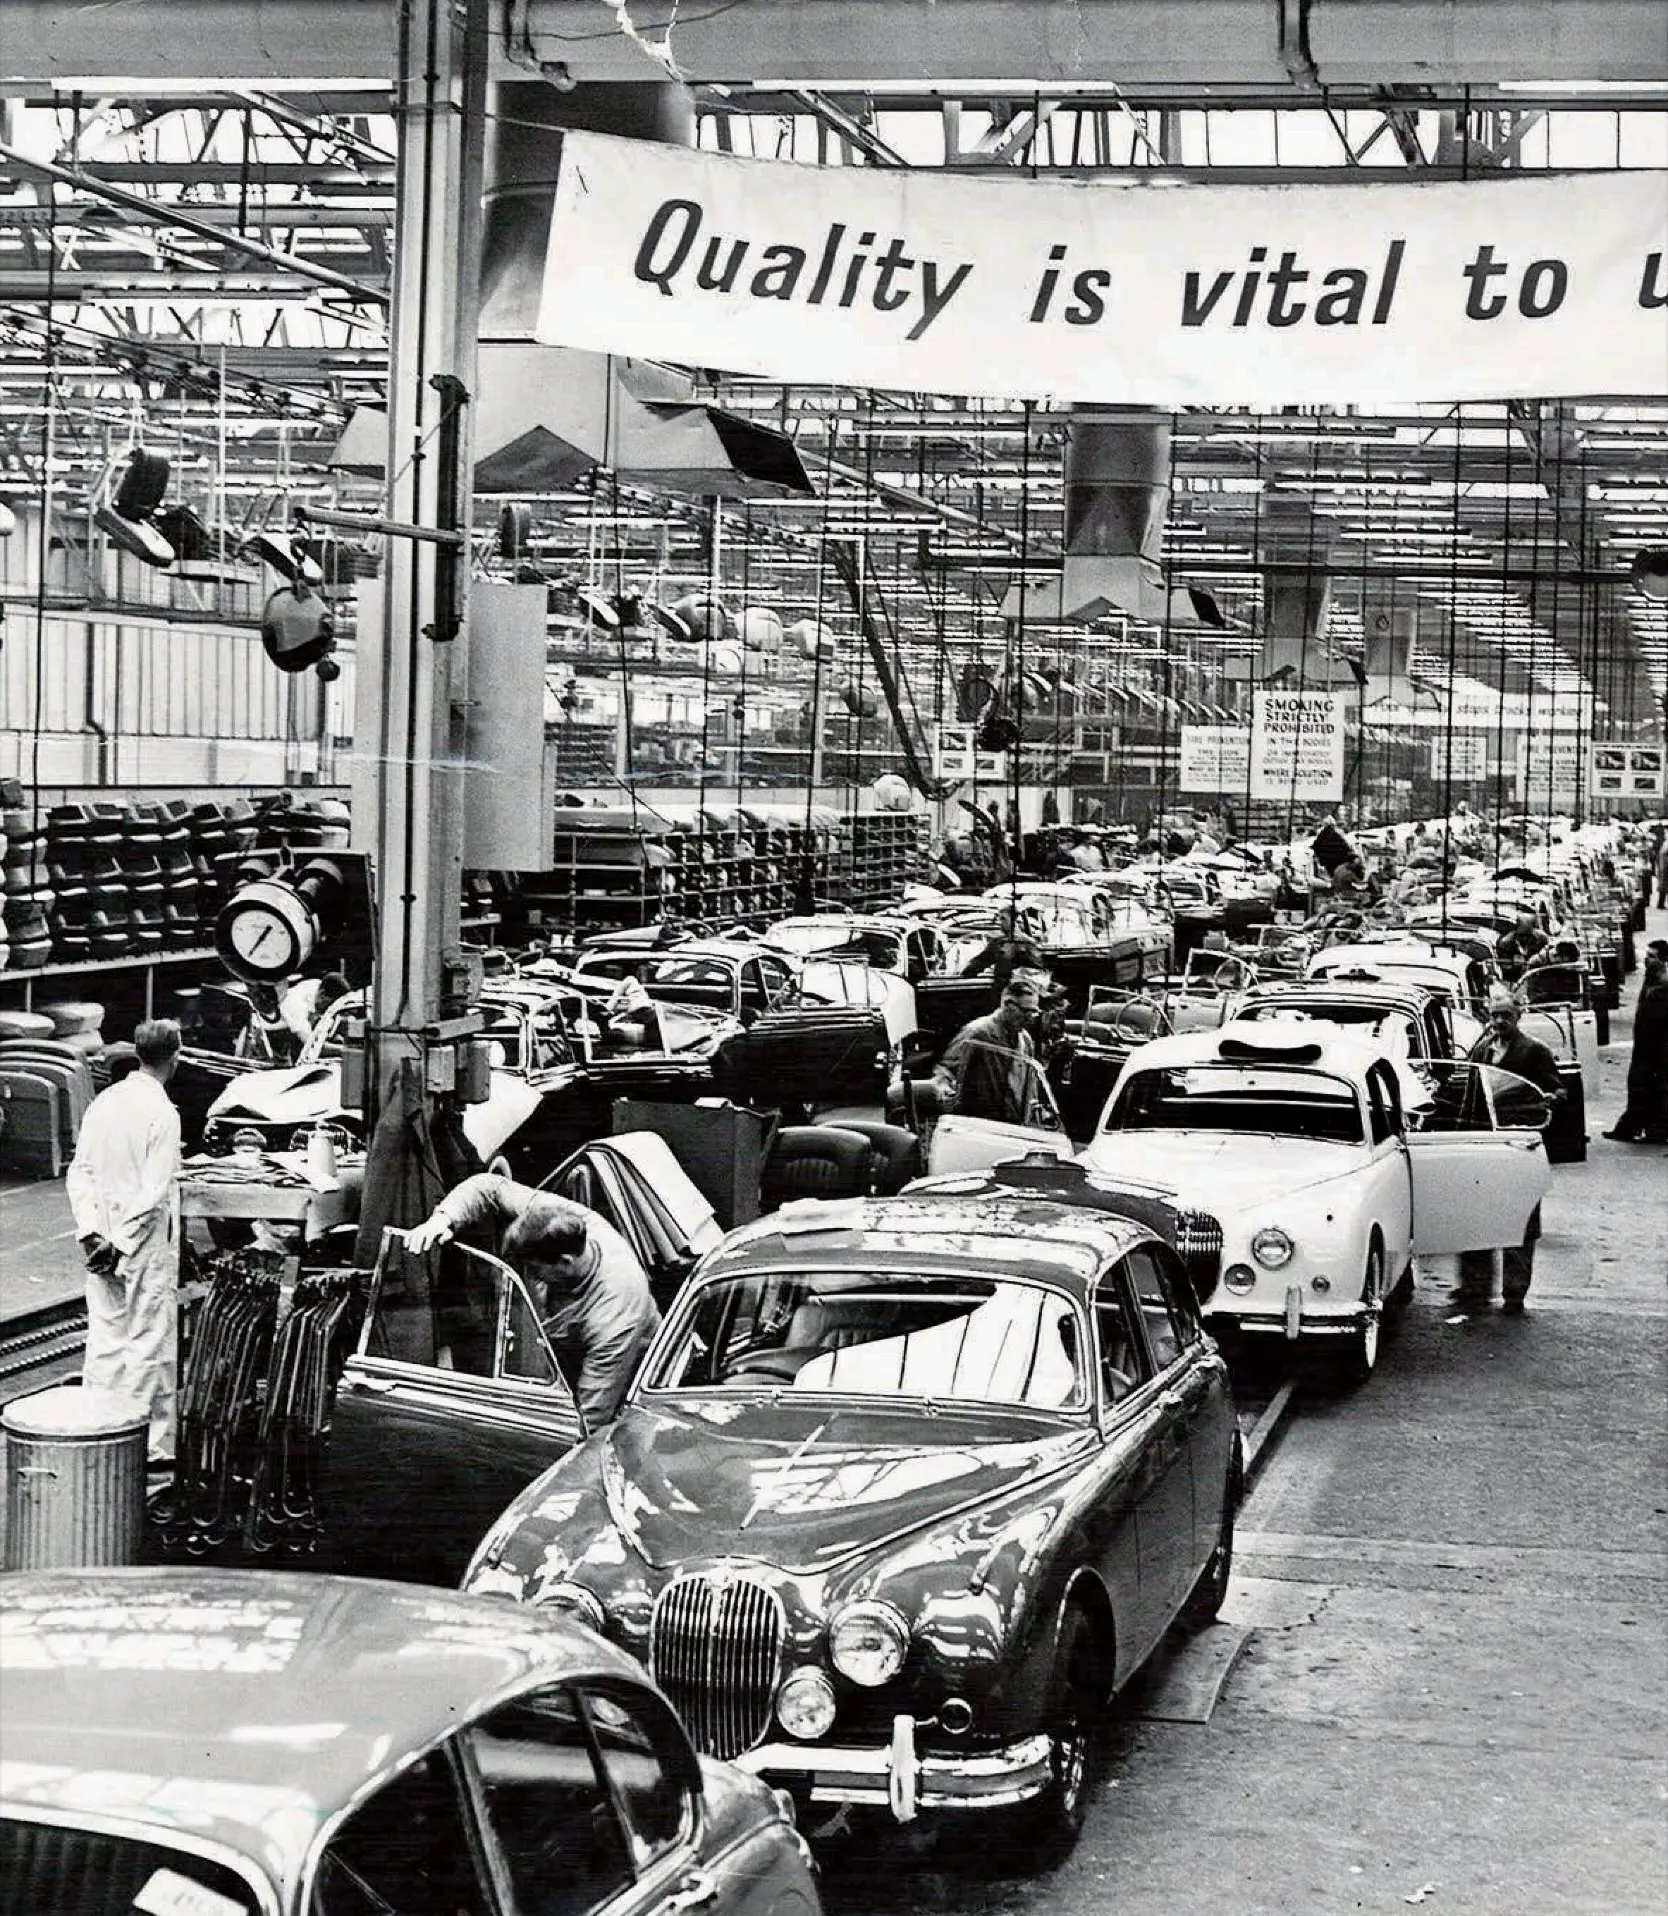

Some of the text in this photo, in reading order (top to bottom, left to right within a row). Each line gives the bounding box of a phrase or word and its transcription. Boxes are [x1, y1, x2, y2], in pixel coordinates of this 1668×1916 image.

[634, 198, 974, 341] Quality
[1030, 245, 1111, 325] is
[1181, 239, 1406, 328] vital
[1463, 245, 1568, 321] to
[1264, 698, 1335, 712] SMOKING
[1265, 711, 1328, 722] STRICTLY
